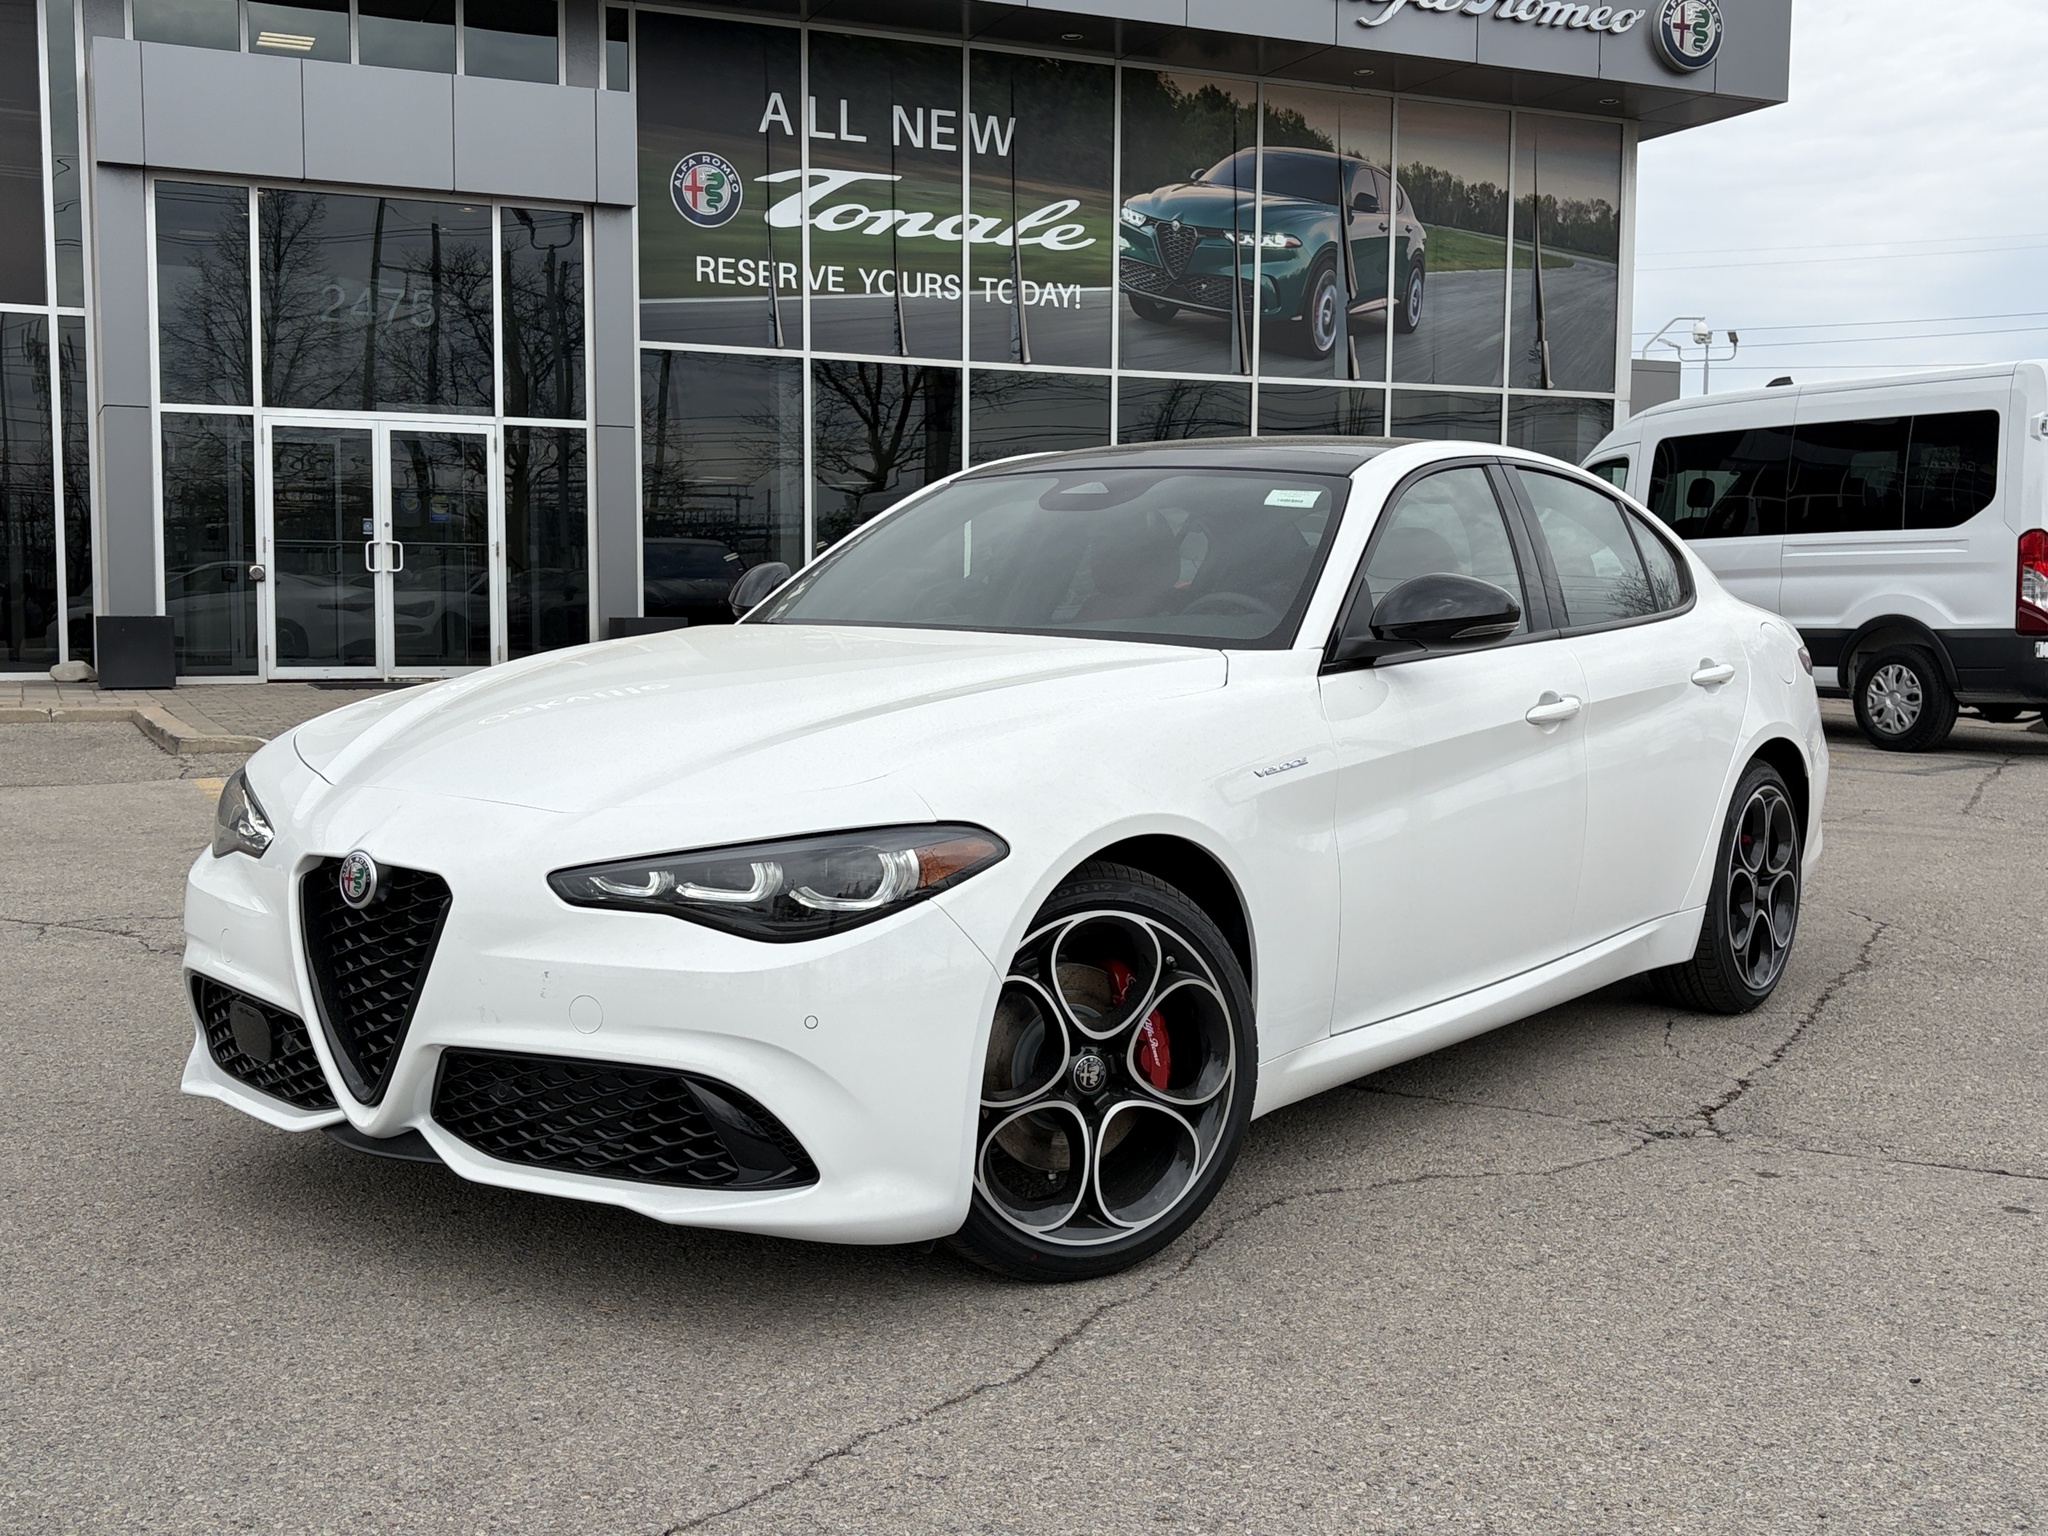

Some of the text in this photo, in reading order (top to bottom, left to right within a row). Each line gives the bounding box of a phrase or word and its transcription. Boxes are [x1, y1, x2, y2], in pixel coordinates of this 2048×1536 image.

[758, 91, 1016, 157] ALL NEW
[674, 155, 739, 193] ALFA ROMEO
[753, 168, 1097, 251] Tonale
[695, 255, 846, 293] RESERVE
[858, 267, 962, 301] YOURS
[317, 284, 437, 329] 2475
